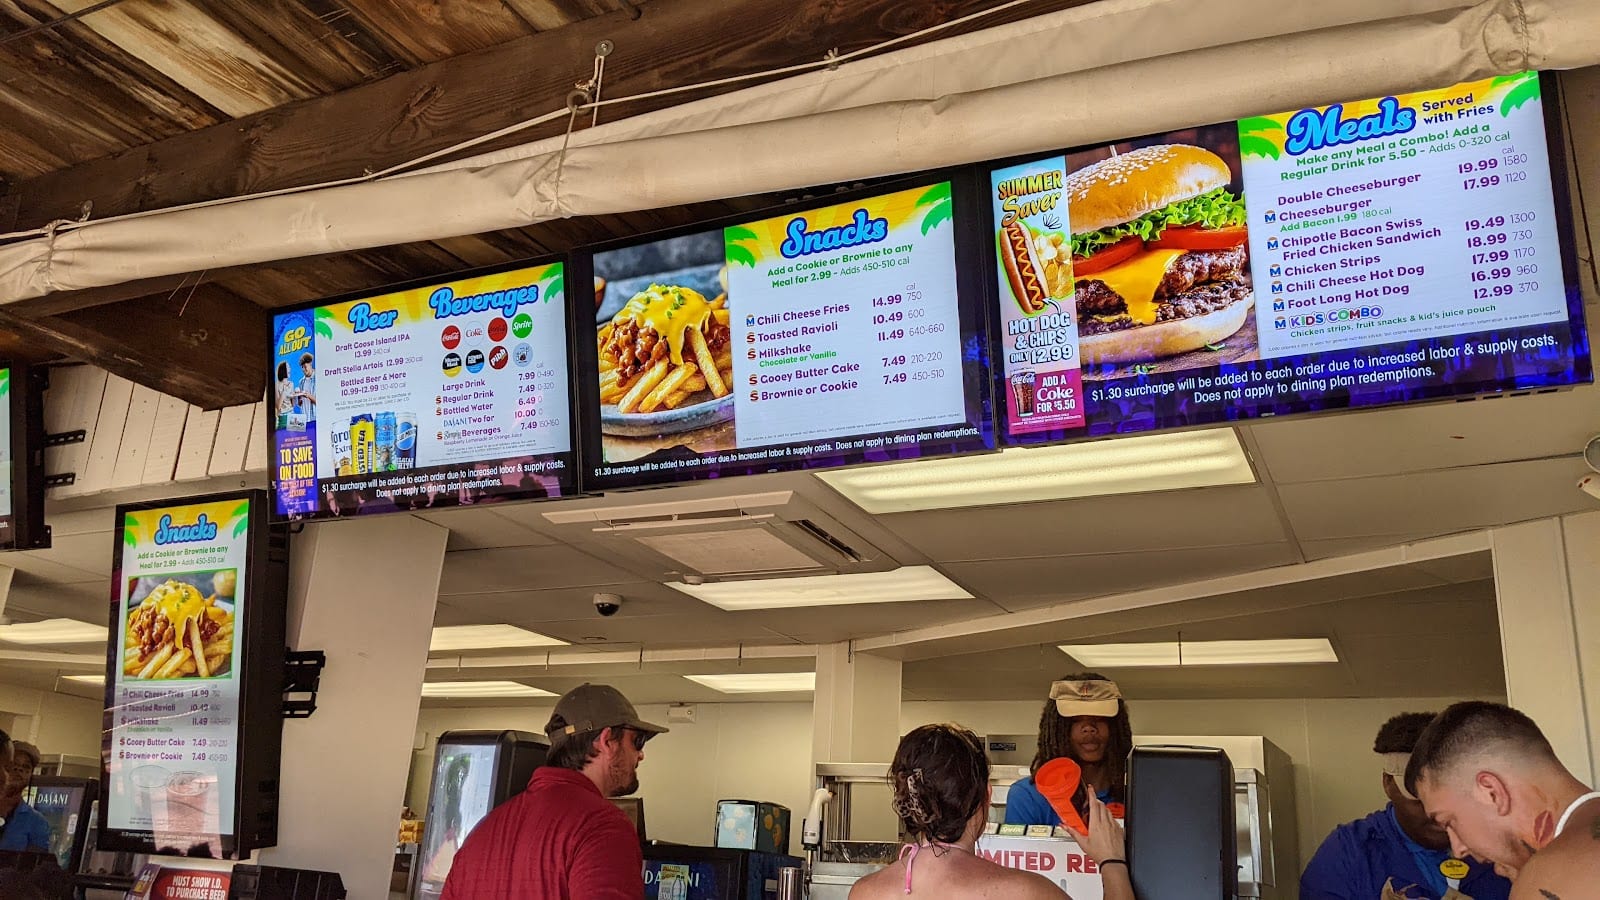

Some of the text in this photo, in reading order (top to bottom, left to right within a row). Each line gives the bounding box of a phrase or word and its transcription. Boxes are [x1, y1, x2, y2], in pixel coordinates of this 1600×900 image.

[1285, 93, 1473, 155] Meals Served
[1424, 104, 1494, 125] with Fries
[1296, 125, 1478, 166] Make any Meal Combo! Add
[1280, 135, 1491, 181] Regular Drink 5.50 0-320
[998, 170, 1063, 200] SUMMER
[1278, 154, 1527, 206] Double Cheeseburger 19.99 1580
[1463, 171, 1526, 190] 17.99 1120
[1002, 192, 1061, 228] Saver
[1279, 198, 1372, 221] Cheeseburger
[1280, 213, 1357, 232] Add Bacon 1.99
[1282, 212, 1535, 249] Chipotle Bacon Swiss 19.49 1300
[780, 209, 888, 259] Snacks
[1283, 227, 1441, 261] Fried Chicken Sandwich
[768, 244, 913, 277] Add Cookie Brownie any
[1284, 230, 1532, 277] Chicken Strips 18.99 730
[772, 260, 895, 289] Meal 2.99 450-510
[1286, 247, 1535, 293] Chili Cheese Hot Dog 17.99 1170
[1288, 264, 1538, 309] Foot Long Hot Dog 16.99 960
[429, 284, 538, 319] Beverages
[872, 292, 922, 308] 14.99 750
[1328, 306, 1382, 322] COMBO
[1474, 285, 1513, 299] 12.99
[1519, 282, 1538, 293] 370
[348, 302, 398, 333] Beer
[757, 303, 924, 326] Chili Cheese Fries 10.49 600
[1008, 312, 1070, 335] HOT DOG
[1290, 304, 1496, 338] Chicken strips, fruit snacks kid's juice pouch
[284, 326, 305, 343] GO
[513, 320, 532, 331] Sprite
[758, 322, 944, 342] Toasted Ravioli 11.49 640-660
[336, 343, 352, 352] Draft
[354, 341, 374, 349] Goose
[376, 335, 396, 345] Island
[1029, 329, 1066, 348] CHIPS
[355, 349, 371, 358] 13.99
[759, 344, 812, 358] Milkshake
[759, 351, 837, 368] Chocolate Vanilla
[1010, 344, 1073, 364] ONLY 12.99
[324, 358, 403, 376] Draft Stella Artois 12.99
[760, 352, 942, 384] Gooey Butter Cake 7.49 210-220
[1092, 333, 1558, 402] $1.30 surcharge will added each order increased labor supply costs.
[341, 378, 364, 387] Bottled
[366, 375, 381, 383] Beer
[465, 379, 485, 387] Drink
[518, 372, 535, 380] 7.99
[761, 369, 944, 401] Brownie Cookie 7.49 450-510
[443, 385, 535, 404] Regular Drink 7.49
[1037, 387, 1074, 400] Coke
[443, 405, 469, 415] Bottled
[519, 397, 535, 405] 6.49
[515, 409, 536, 418] 10.00
[1036, 399, 1075, 413] FOR $5.50
[462, 427, 501, 437] Beverages
[293, 446, 313, 463] SAVE
[293, 463, 314, 479] FOOD
[154, 513, 217, 545] Snacks
[37, 793, 68, 805] DASANI
[976, 849, 1056, 871] MITED
[173, 876, 189, 886] MUST
[191, 877, 210, 888] SHOW
[645, 870, 699, 887] DANI
[176, 888, 226, 900] PURCHASE BEER
